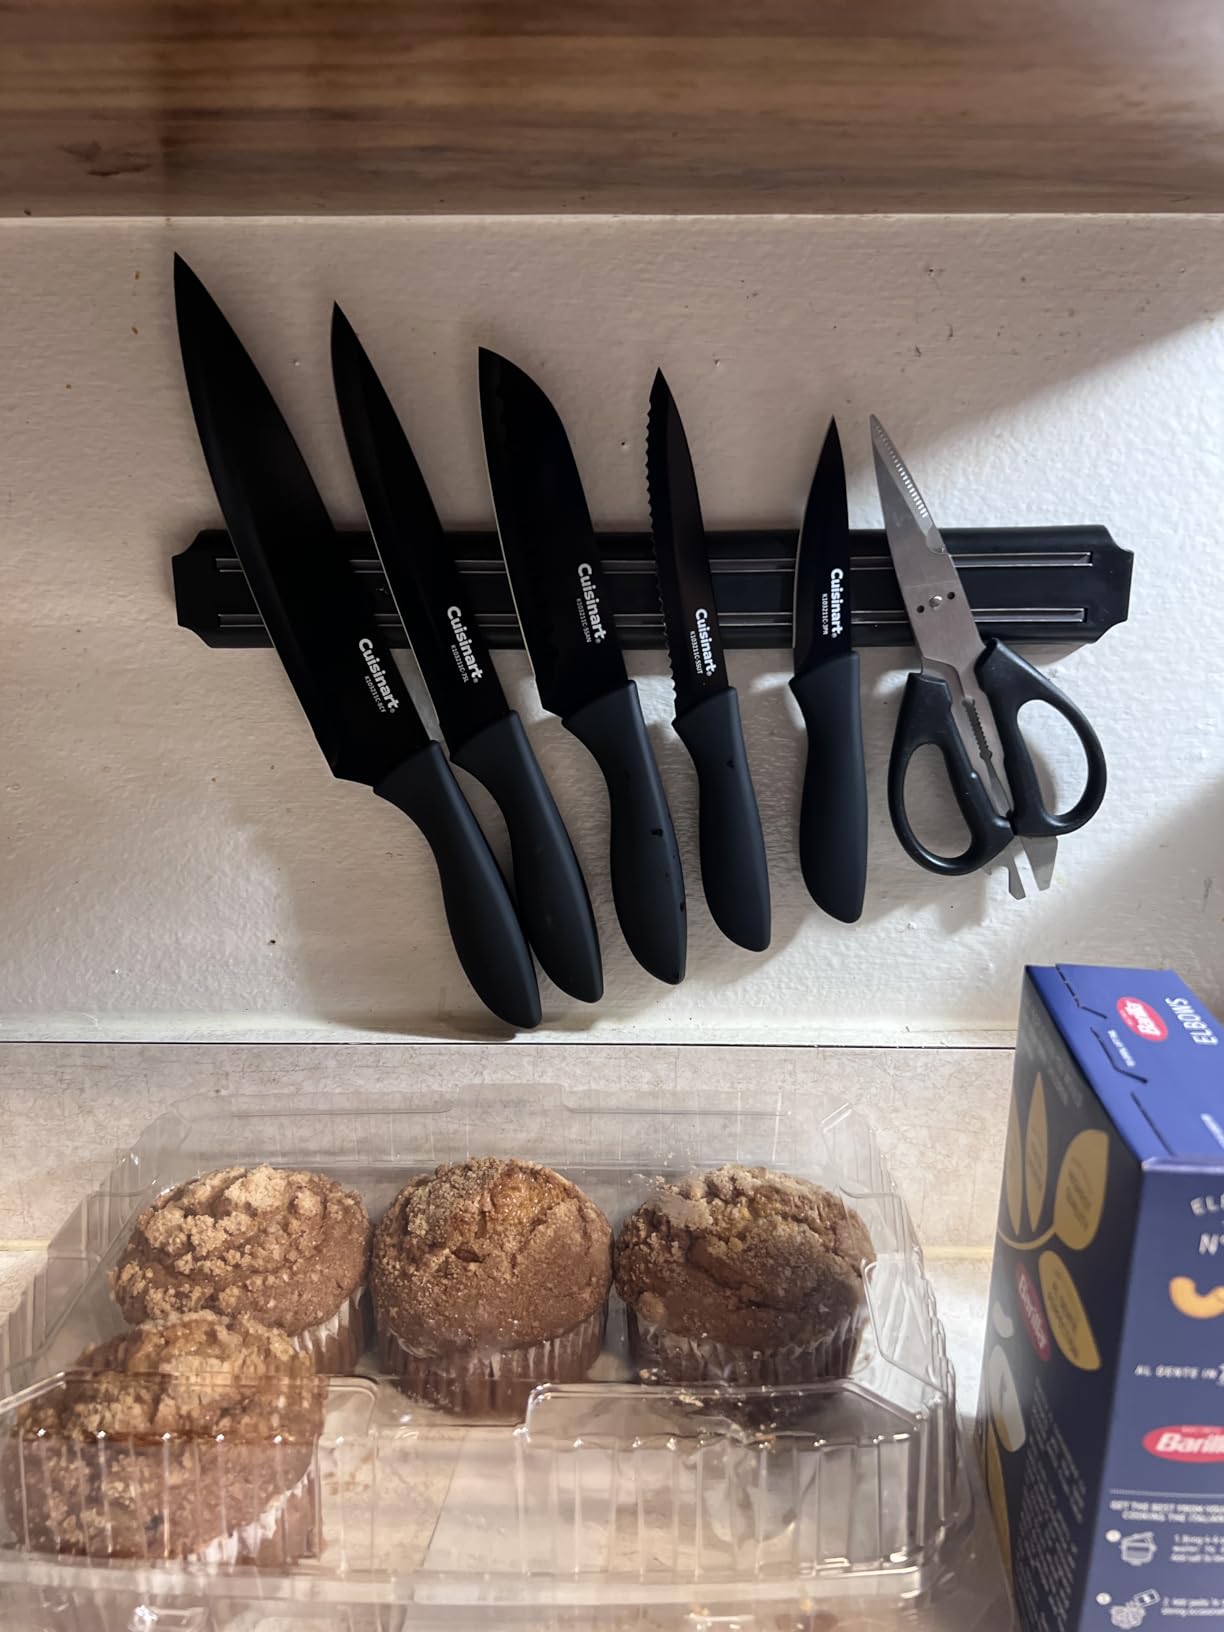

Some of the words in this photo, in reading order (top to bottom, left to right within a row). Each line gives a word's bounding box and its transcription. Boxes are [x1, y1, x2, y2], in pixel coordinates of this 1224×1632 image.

[577, 562, 607, 642] Cuisinart
[830, 568, 843, 637] Cuisinart
[358, 638, 399, 713] Cuisinart
[447, 605, 483, 682] Cuisinart
[695, 608, 717, 676] Cuisinart
[1165, 998, 1218, 1046] ELBOWS
